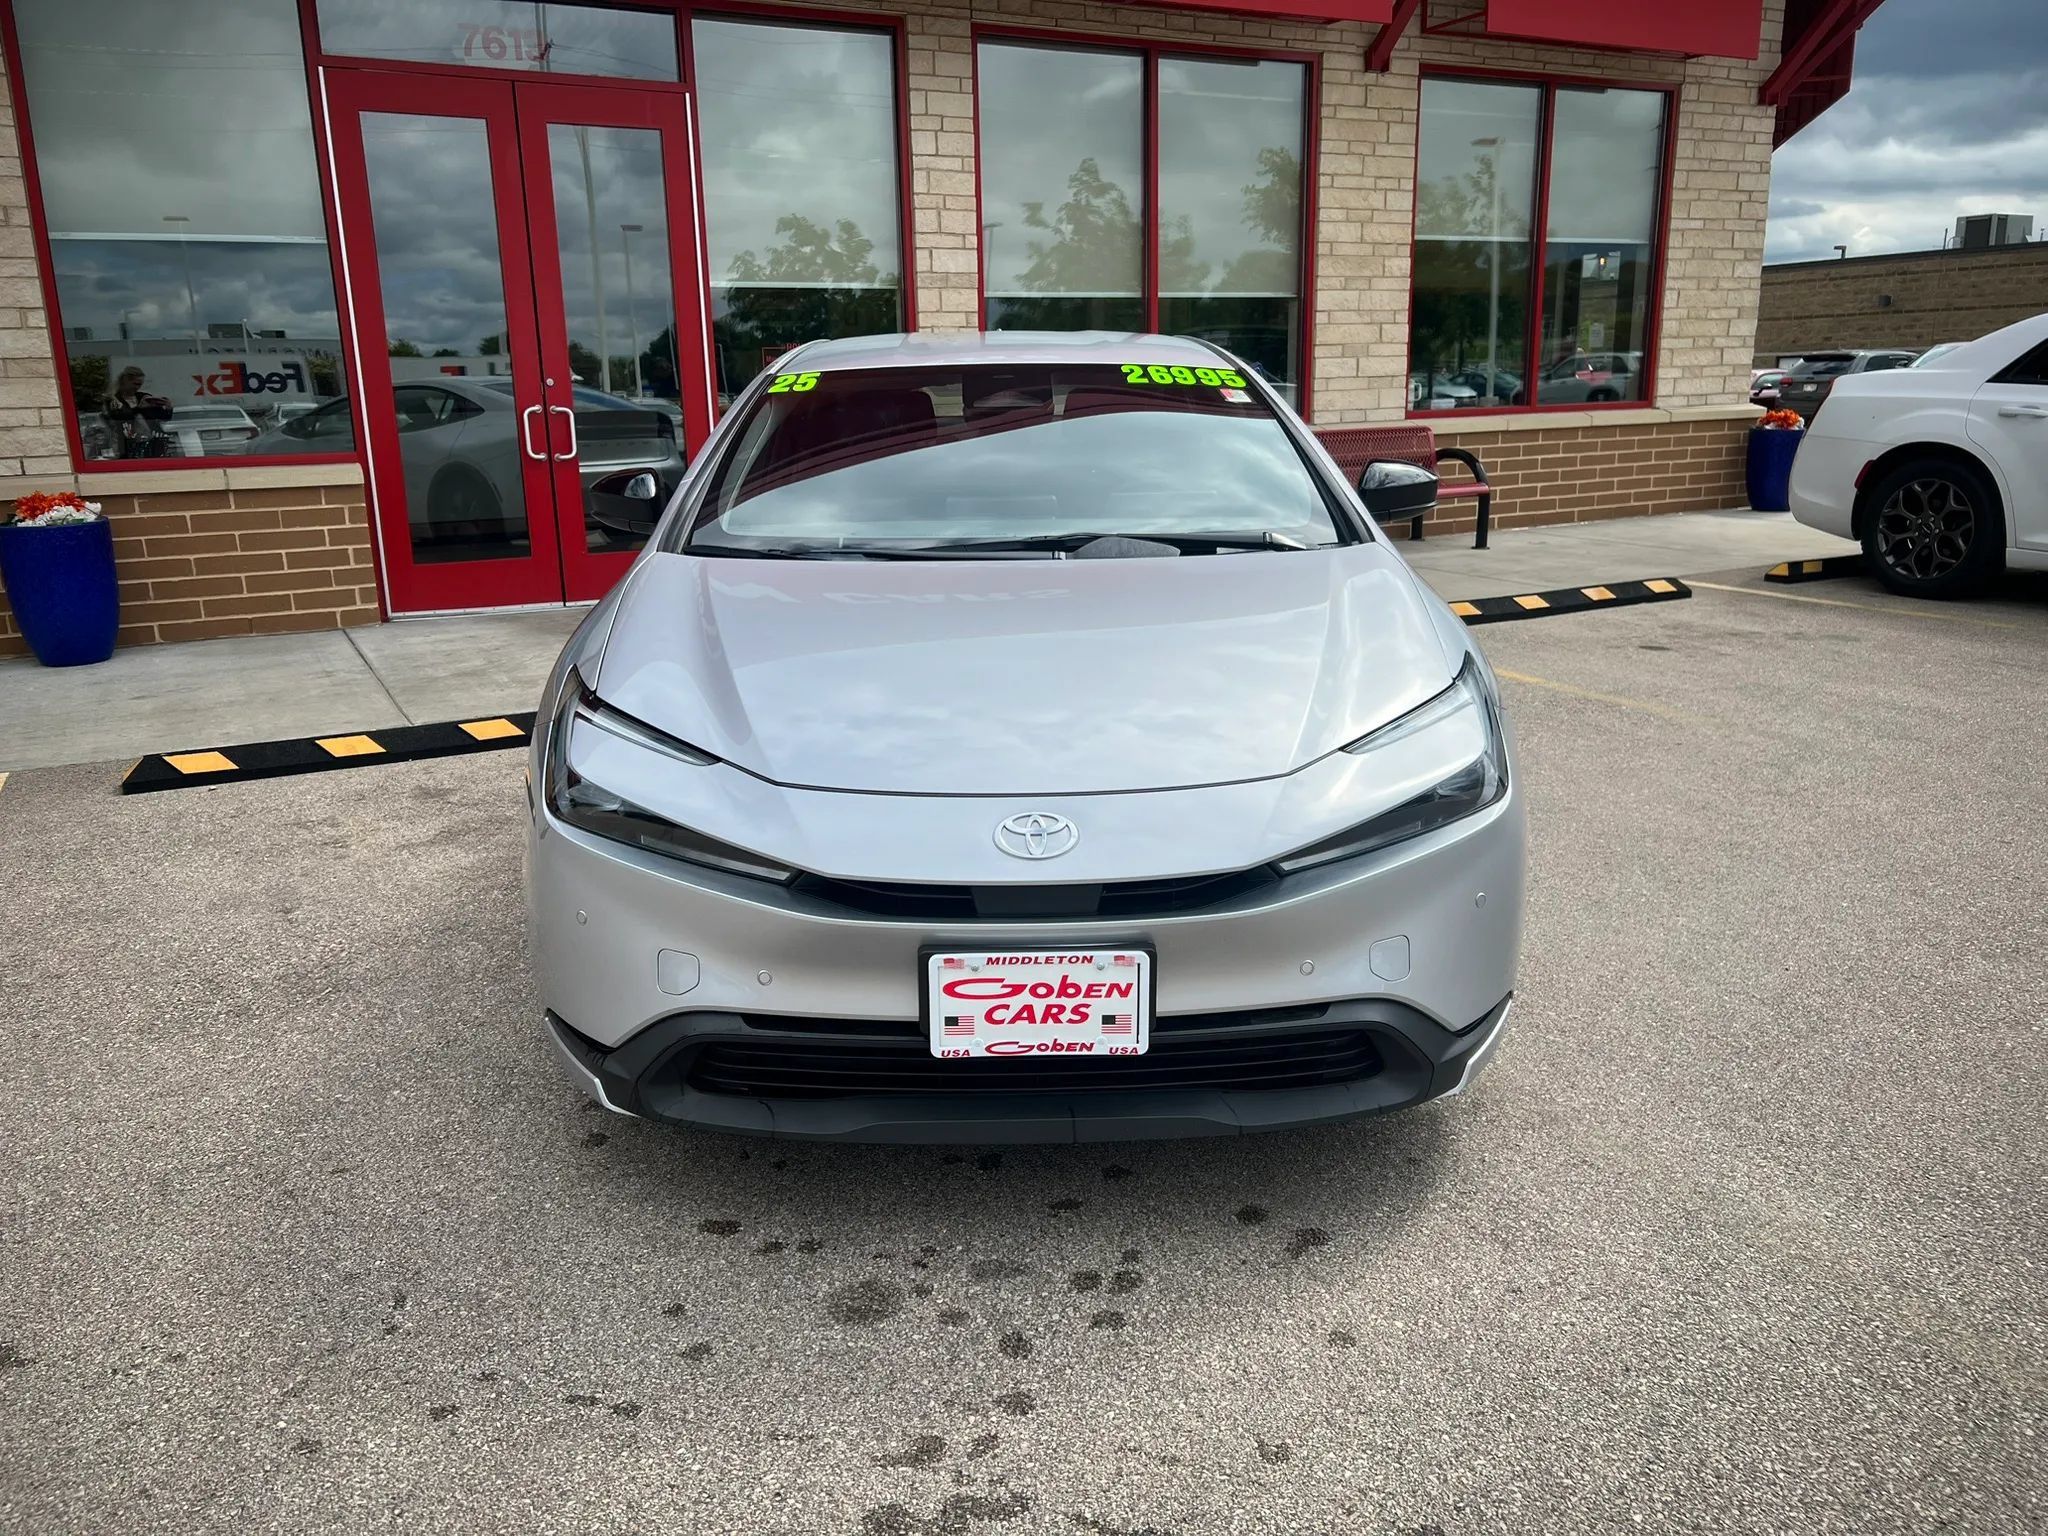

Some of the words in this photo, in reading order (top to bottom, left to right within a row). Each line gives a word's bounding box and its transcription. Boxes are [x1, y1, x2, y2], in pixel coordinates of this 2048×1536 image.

[457, 22, 549, 62] 7613
[768, 373, 821, 393] 25
[1121, 364, 1247, 388] 26995
[986, 955, 1094, 966] MIDDLETON
[984, 1003, 1092, 1025] CARS
[941, 1049, 971, 1058] USA
[1108, 1046, 1139, 1056] USA
